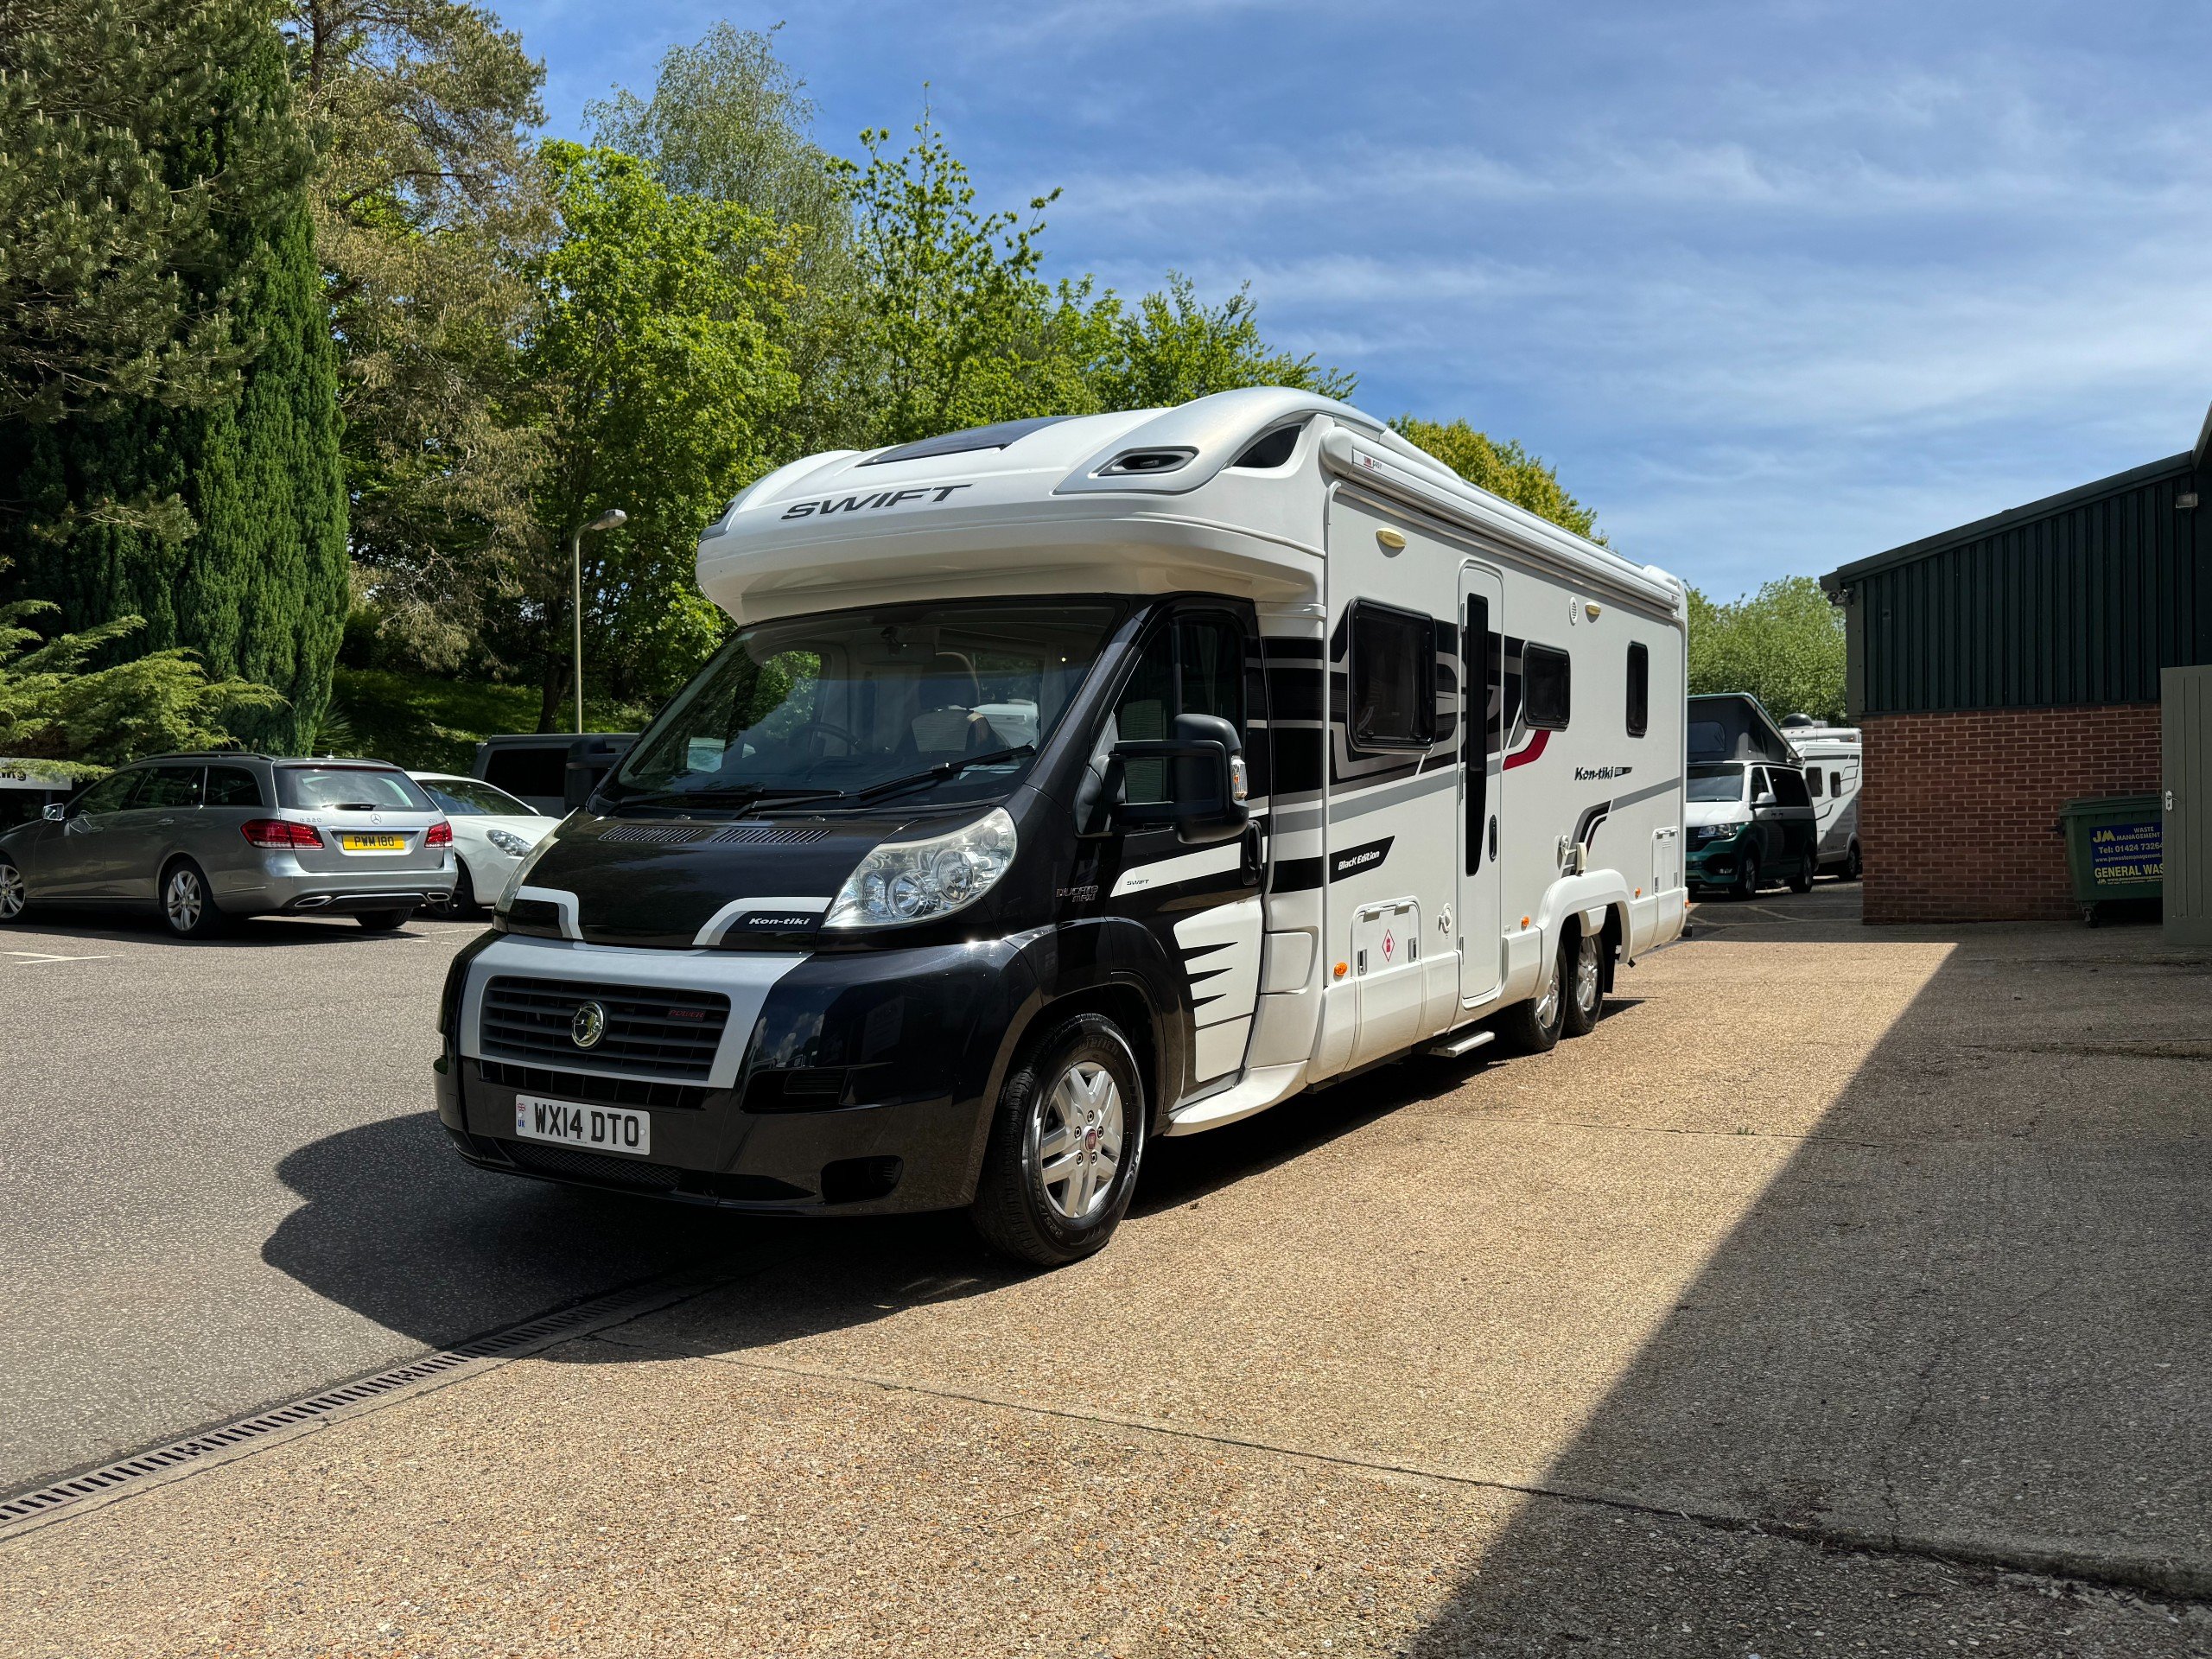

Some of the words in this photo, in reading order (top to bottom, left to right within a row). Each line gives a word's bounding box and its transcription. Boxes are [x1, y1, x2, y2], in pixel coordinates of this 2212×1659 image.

[780, 483, 974, 520] SWIFT
[1574, 766, 1614, 781] Kon-tiki
[354, 836, 376, 847] PWM
[378, 836, 394, 847] 180
[2092, 830, 2116, 843] JM
[2117, 832, 2160, 841] MANAGEMENT
[2114, 844, 2139, 853] 01424
[1357, 850, 1380, 864] Edition
[2094, 865, 2142, 878] GENERAL
[1056, 885, 1099, 898] DUCATO
[669, 1009, 705, 1018] POWER
[518, 1119, 525, 1128] UK
[534, 1102, 583, 1140] WX14
[591, 1110, 639, 1147] DTO
